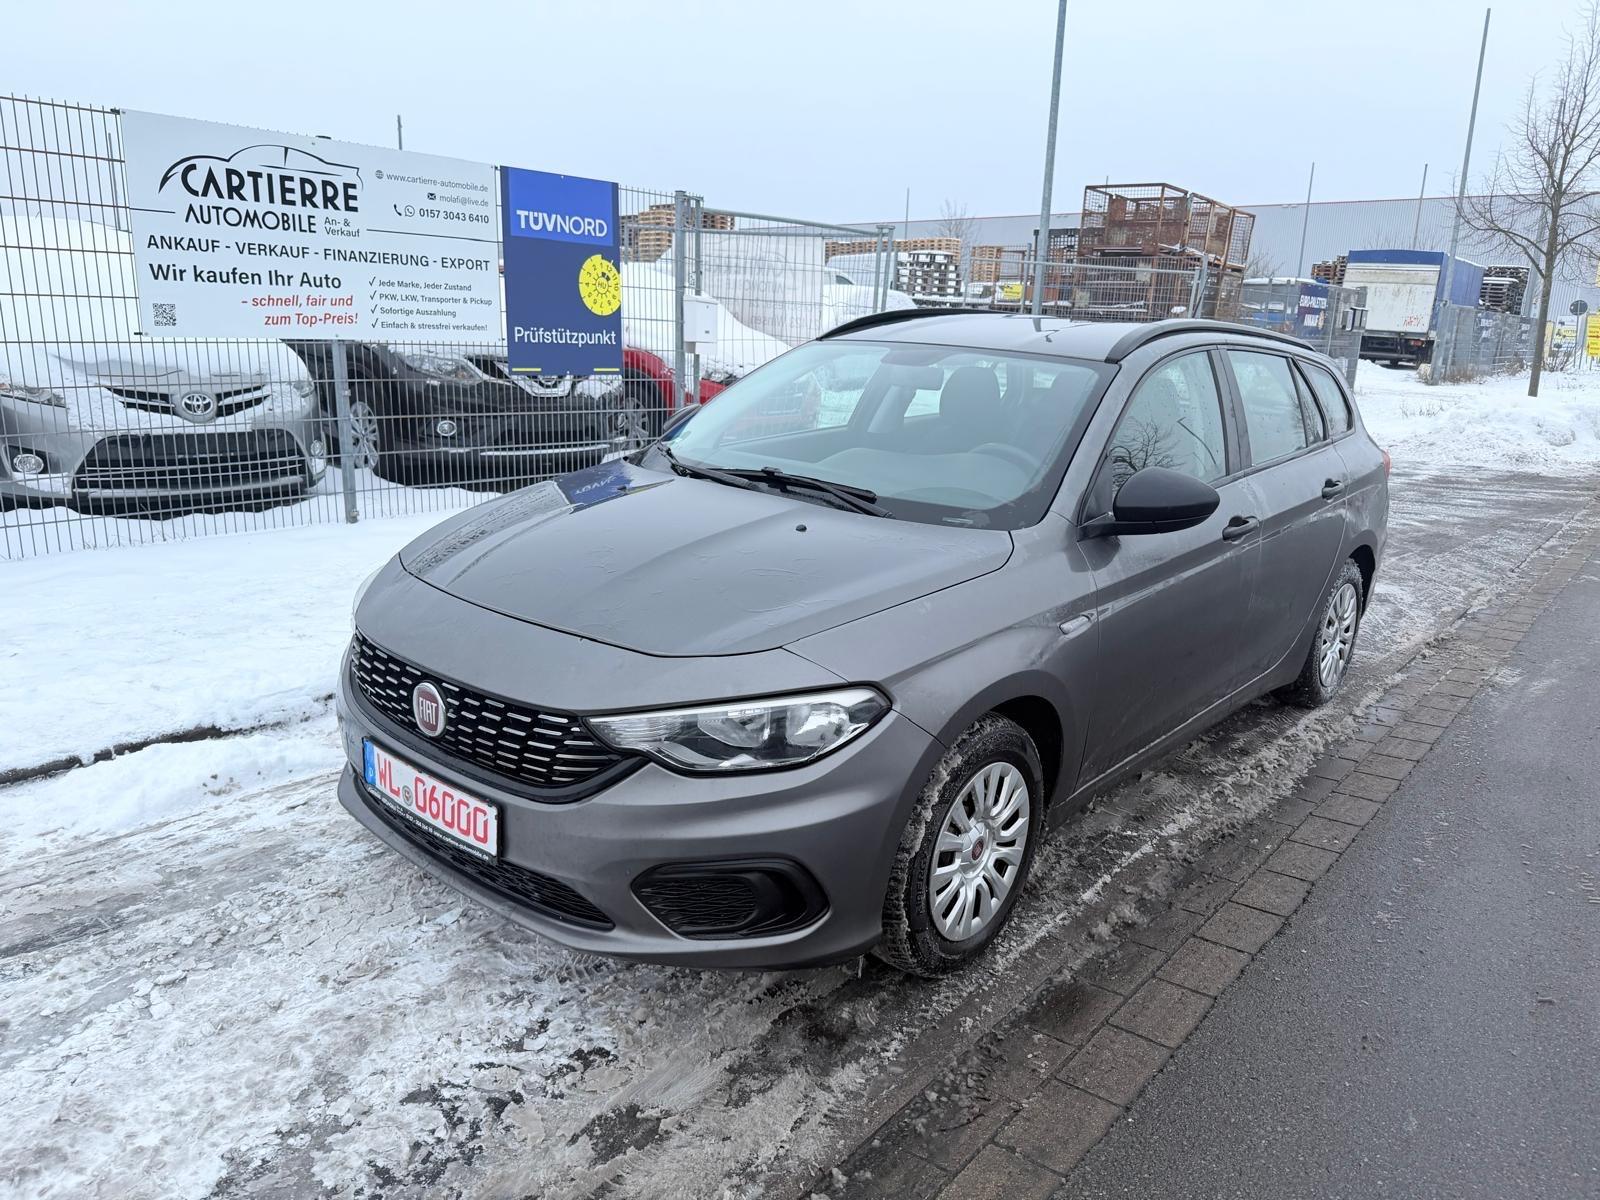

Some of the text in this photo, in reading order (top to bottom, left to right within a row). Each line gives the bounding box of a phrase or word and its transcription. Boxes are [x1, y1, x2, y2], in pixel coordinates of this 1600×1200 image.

[181, 163, 359, 212] CARTIERRE
[386, 172, 488, 193] www.cartierre-automobile.de
[185, 203, 317, 234] AUTOMOBILE
[419, 208, 490, 224] 0157 3043 6410
[324, 226, 360, 237] Verkauf
[147, 234, 221, 253] ANKAUF
[235, 241, 310, 259] VERKAUF
[323, 248, 429, 268] FINANZIERUNG
[441, 256, 491, 271] EXPORT
[149, 263, 342, 289] Wir kaufen Ihr Auto
[378, 278, 472, 292] Jede Marke, Jeder Zustand
[251, 294, 302, 309] schnell,
[306, 294, 328, 307] fair
[330, 295, 354, 307] und
[379, 293, 399, 303] PKW,
[400, 294, 420, 304] LKW,
[420, 295, 461, 306] Transporter
[470, 297, 493, 307] Pickup
[264, 312, 359, 328] zum Top-Preis!
[380, 306, 457, 318] Sofortige Auszahlung
[381, 321, 409, 330] Einfach
[418, 322, 451, 331] stressfrei
[452, 322, 488, 332] verkaufen!
[514, 326, 617, 348] Prüfstützpunkt
[418, 697, 438, 726] FIAT
[376, 751, 401, 798] WL
